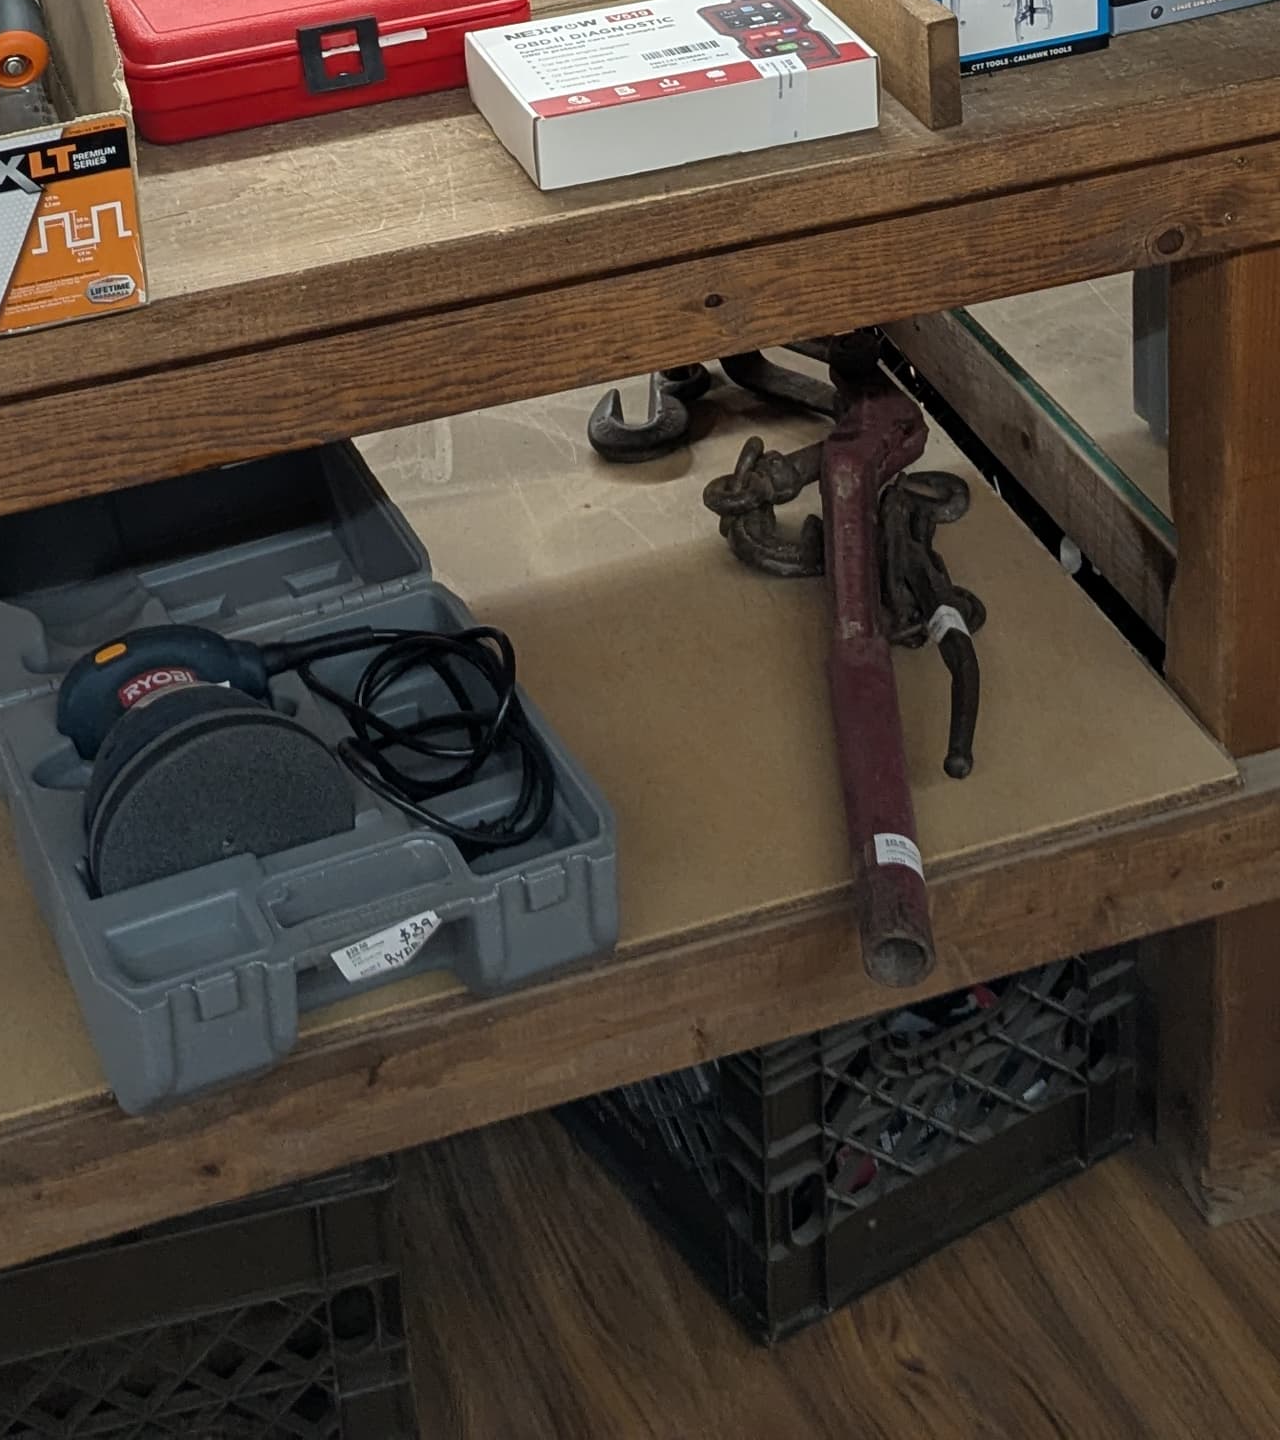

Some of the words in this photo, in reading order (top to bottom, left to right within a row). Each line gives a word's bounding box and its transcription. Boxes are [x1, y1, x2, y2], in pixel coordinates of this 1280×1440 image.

[513, 37, 551, 51] OBD
[569, 16, 676, 41] DIAGNOSTIC
[1050, 45, 1073, 57] TOOLS
[72, 146, 117, 162] PREMIUM
[73, 157, 108, 171] SERIES
[89, 281, 131, 297] LIFETIME
[122, 669, 194, 701] RYOBI
[399, 917, 434, 946] $39
